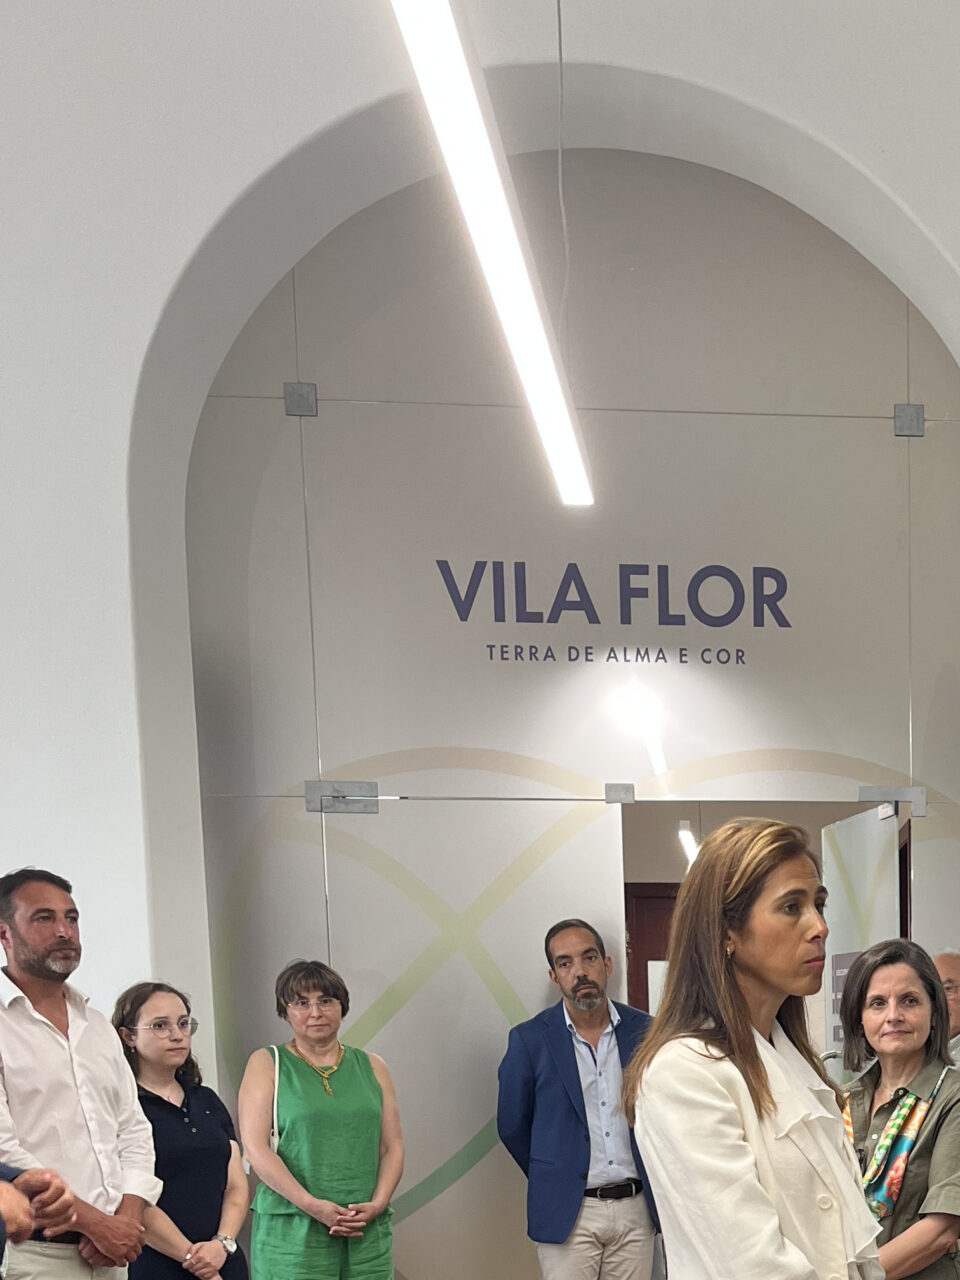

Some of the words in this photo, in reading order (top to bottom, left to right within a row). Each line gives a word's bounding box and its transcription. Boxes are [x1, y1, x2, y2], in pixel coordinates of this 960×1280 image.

[436, 559, 601, 624] VILA
[618, 563, 792, 629] FLOR
[487, 644, 557, 662] TERRA
[567, 646, 594, 662] DE
[606, 647, 668, 664] ALMA
[680, 648, 688, 664] E
[700, 648, 746, 665] COR
